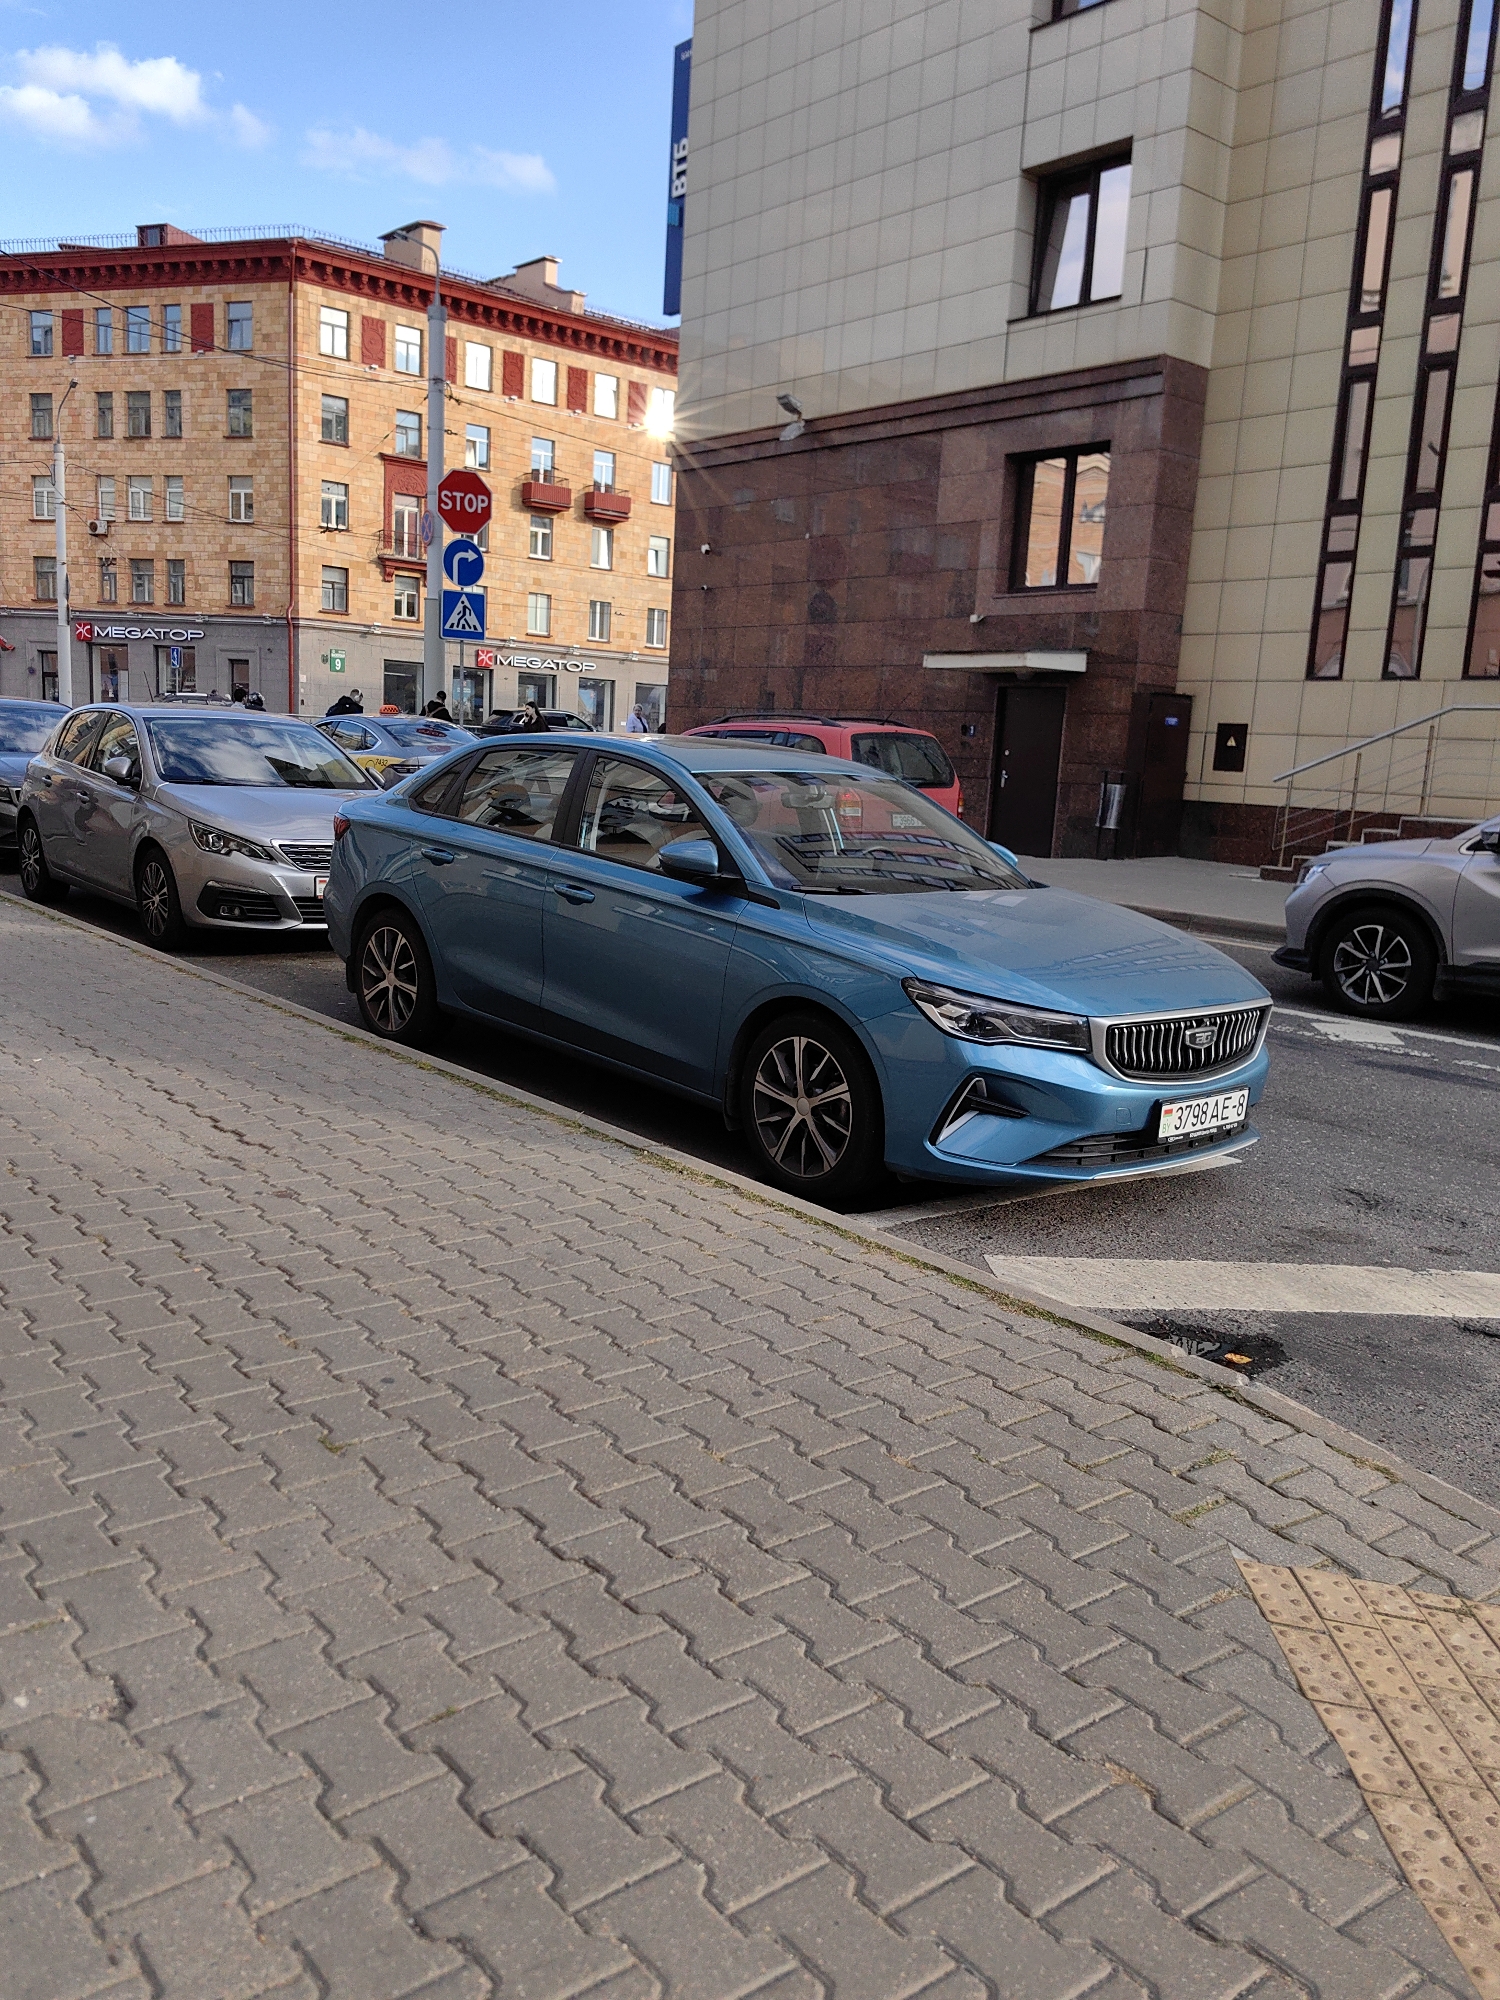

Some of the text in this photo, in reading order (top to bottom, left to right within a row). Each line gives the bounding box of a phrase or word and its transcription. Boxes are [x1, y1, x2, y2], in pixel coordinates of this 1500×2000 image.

[671, 137, 689, 199] ВТБ
[440, 490, 489, 514] STOP
[94, 626, 205, 641] MEGATOP
[335, 658, 342, 671] 9
[496, 654, 597, 672] MEGATOP
[1161, 1122, 1171, 1134] BY
